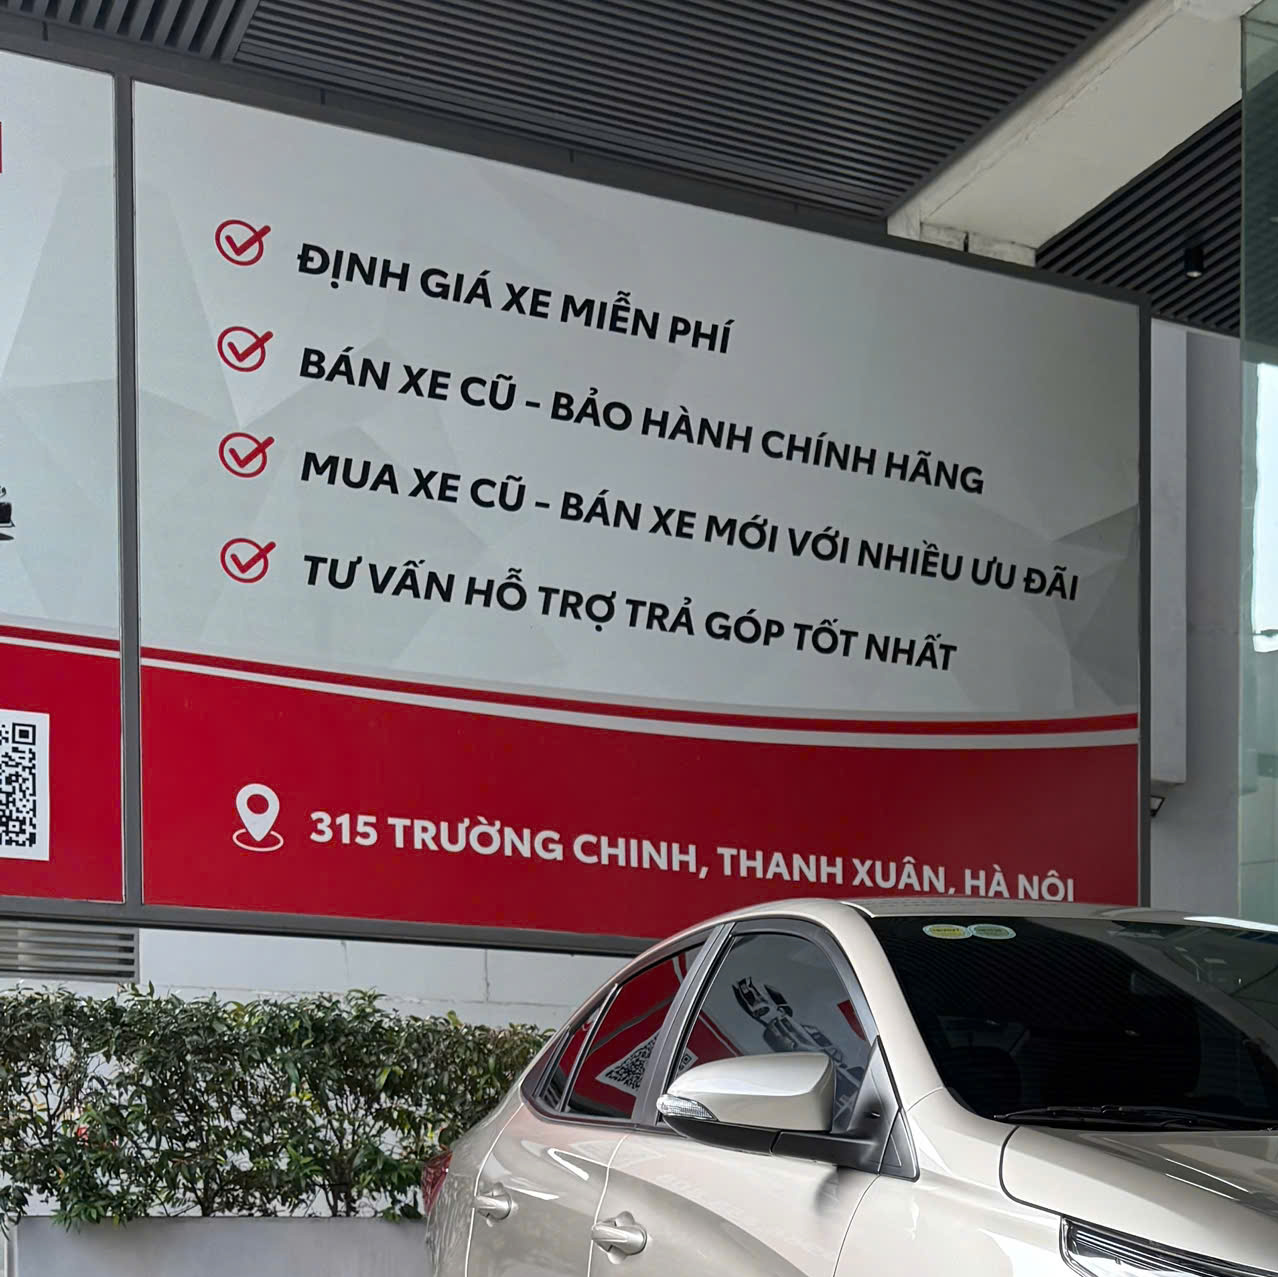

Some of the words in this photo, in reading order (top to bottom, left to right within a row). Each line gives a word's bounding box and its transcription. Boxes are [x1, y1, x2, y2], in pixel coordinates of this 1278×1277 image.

[297, 242, 410, 292] ĐỊNH
[420, 261, 493, 309] GIÁ
[502, 283, 551, 318] XE
[560, 290, 659, 340] MIỄN
[668, 314, 735, 354] PHÍ
[301, 347, 391, 391] BÁN
[398, 364, 451, 401] XE
[460, 373, 516, 412] CŨ
[551, 388, 633, 434] BẢO
[641, 406, 753, 454] HÀNH
[762, 429, 877, 477] CHÍNH
[885, 449, 985, 495] HÃNG
[301, 451, 399, 495] MUA
[409, 468, 459, 503] XE
[470, 475, 527, 513] CŨ
[560, 489, 641, 532] BÁN
[649, 505, 698, 541] XE
[704, 513, 778, 553] MỚI
[788, 526, 849, 565] VỚI
[857, 538, 964, 581] NHIỀU
[970, 557, 1017, 591] ƯU
[1023, 565, 1080, 602] ĐÃI
[303, 554, 363, 590] TƯ
[368, 559, 456, 603] VẤN
[464, 567, 529, 612] HỖ
[537, 584, 617, 632] TRỢ
[625, 597, 696, 636] TRẢ
[704, 609, 785, 648] GÓP
[793, 618, 859, 657] TỐT
[865, 634, 958, 672] NHẤT
[310, 811, 378, 846] 315
[388, 815, 564, 861] TRƯỜNG
[573, 834, 708, 879] CHINH,
[716, 847, 843, 885] THANH
[852, 856, 956, 895] XUÂN,
[964, 863, 1010, 899] HÀ
